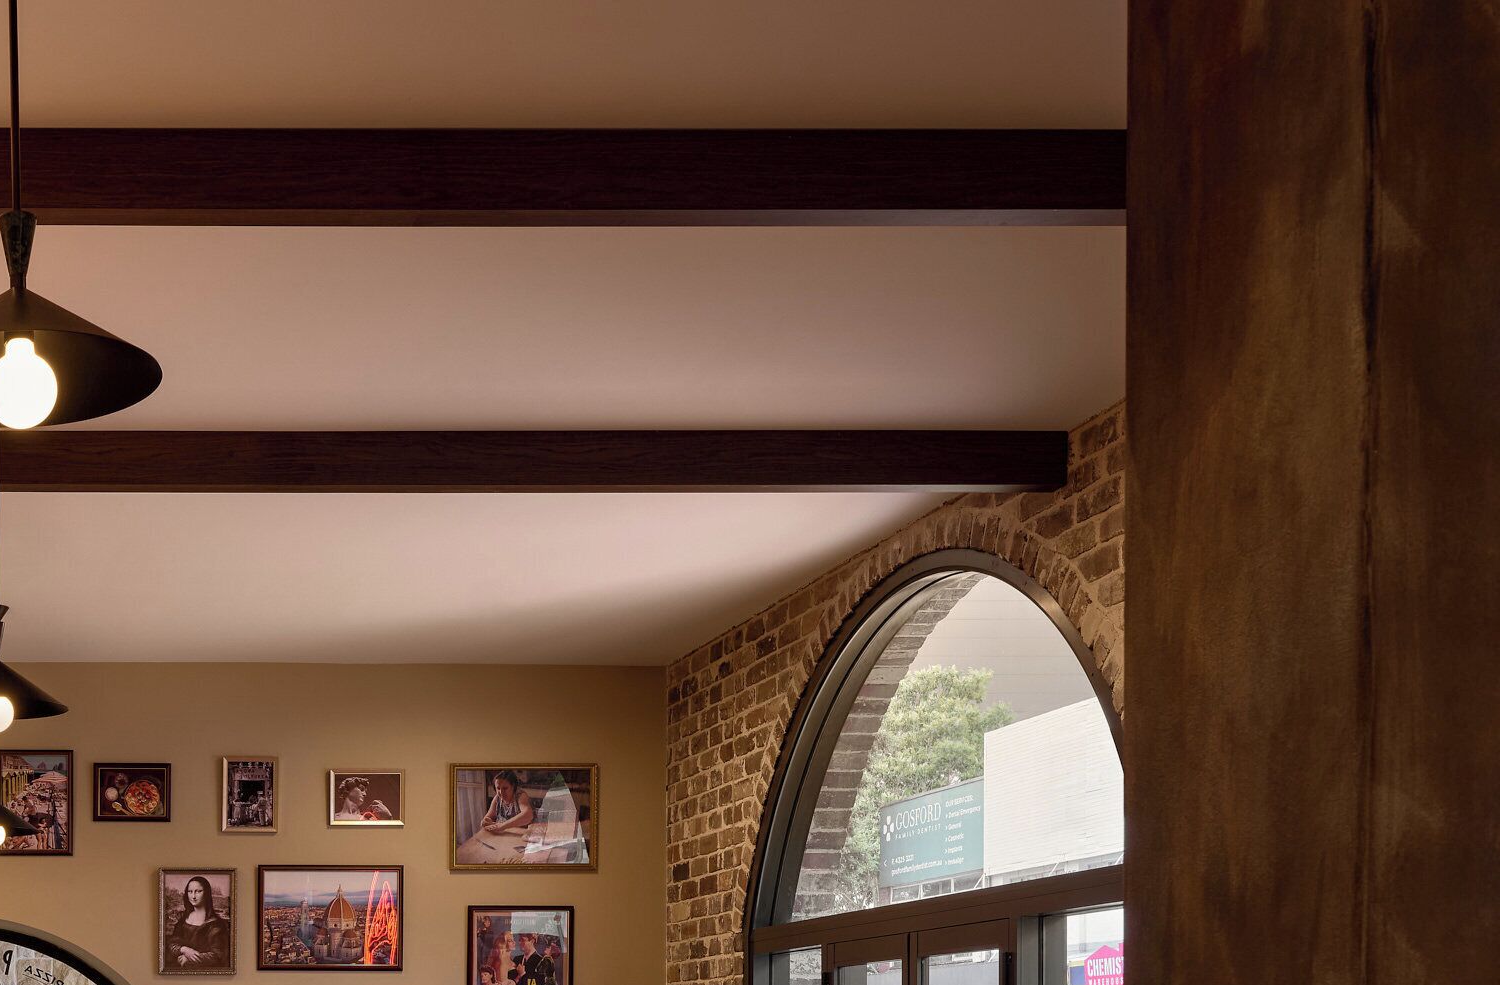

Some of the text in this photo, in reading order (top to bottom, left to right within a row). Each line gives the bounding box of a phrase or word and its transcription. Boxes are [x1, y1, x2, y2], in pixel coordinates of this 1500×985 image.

[896, 802, 941, 830] GOSFORD
[895, 824, 941, 840] FAMILY DENTIST
